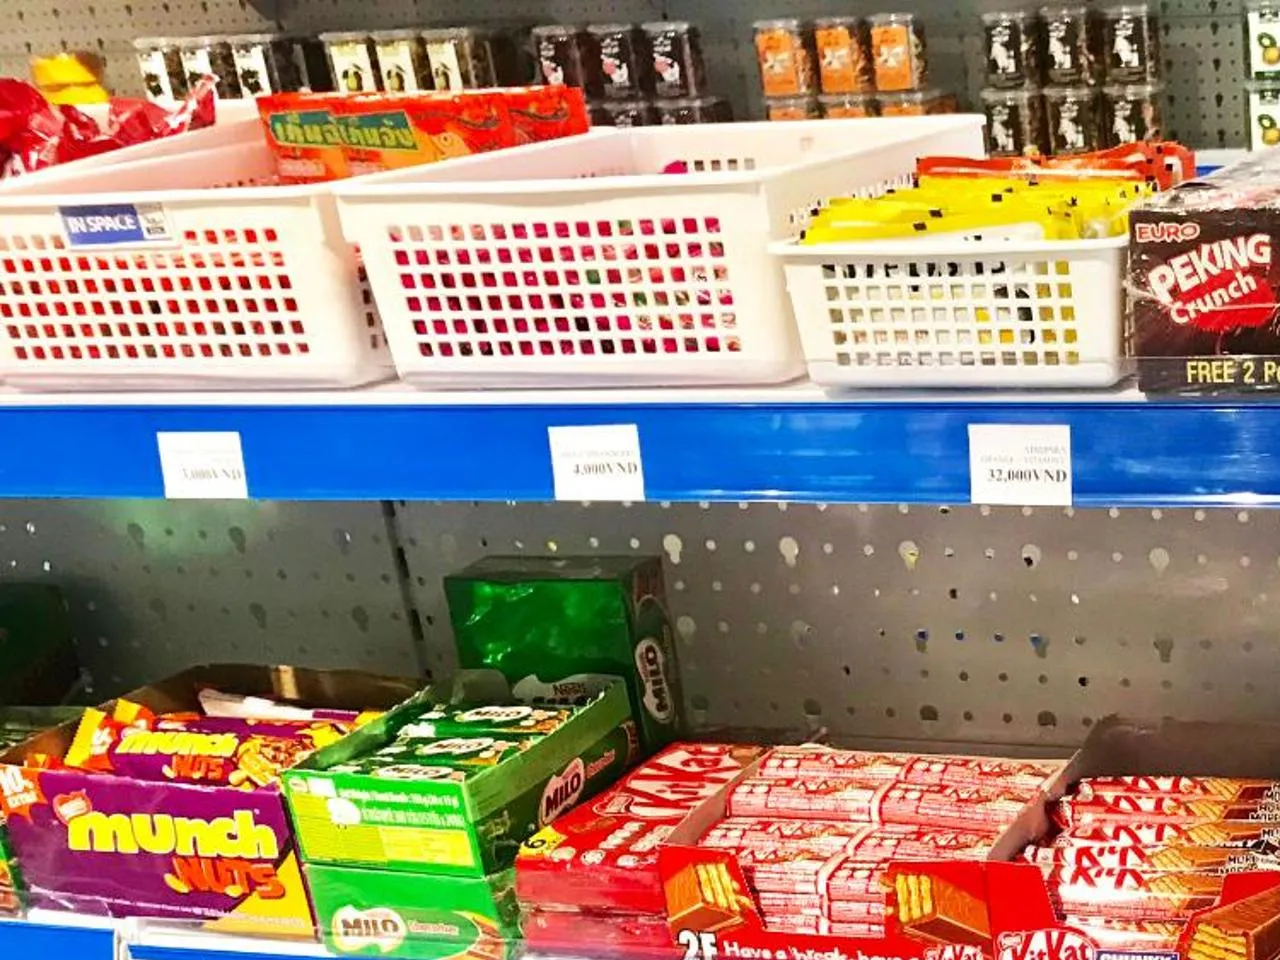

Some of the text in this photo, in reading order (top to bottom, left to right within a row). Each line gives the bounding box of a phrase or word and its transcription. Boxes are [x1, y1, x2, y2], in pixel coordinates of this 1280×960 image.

[68, 214, 137, 233] IN SPACE
[1135, 222, 1200, 243] EURO
[1148, 233, 1272, 303] PEKING
[1170, 273, 1257, 324] Crunch
[1187, 361, 1237, 383] FREE
[1243, 361, 1255, 382] 2
[115, 730, 238, 756] munch
[546, 773, 581, 816] MILO
[68, 810, 278, 858] munch
[170, 856, 285, 899] NUTS
[342, 916, 400, 936] MILO
[724, 941, 771, 958] Have
[775, 949, 788, 960] a
